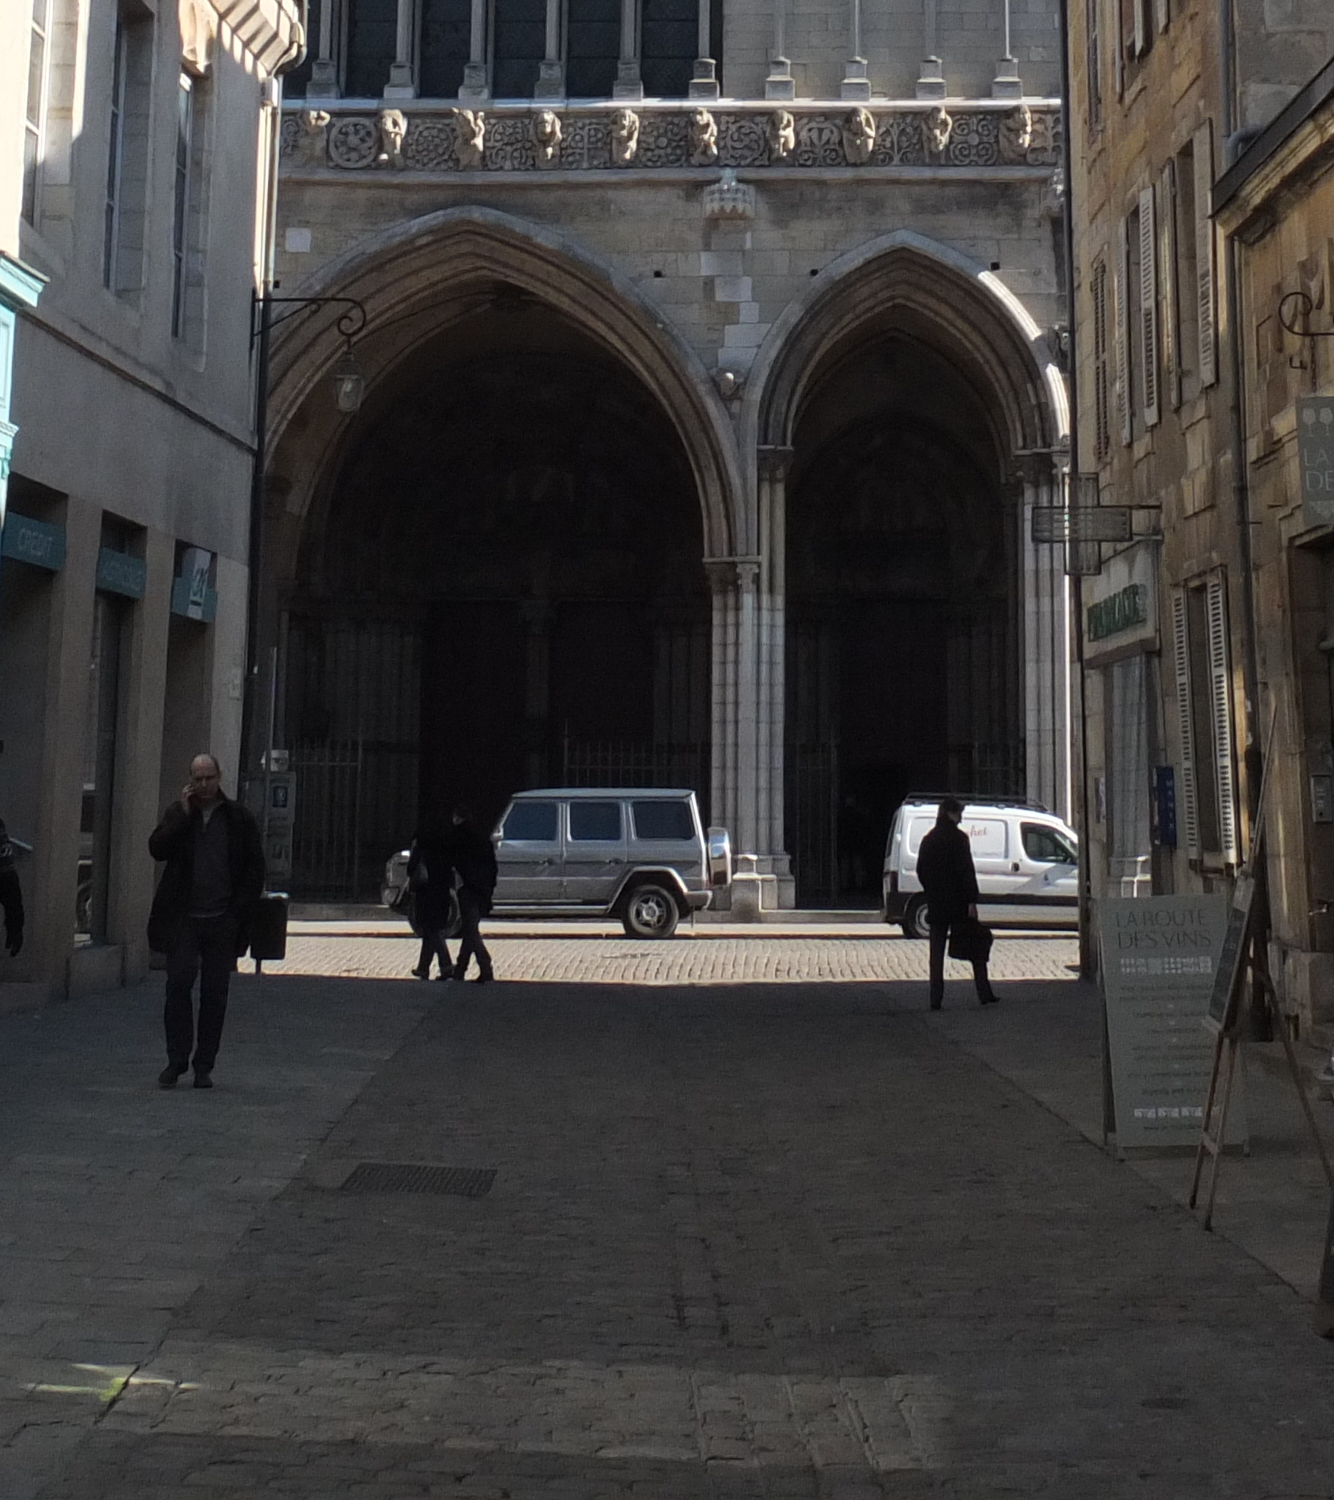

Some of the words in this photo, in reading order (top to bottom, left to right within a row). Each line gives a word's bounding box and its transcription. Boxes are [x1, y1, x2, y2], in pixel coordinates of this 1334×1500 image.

[1304, 447, 1330, 466] LA
[1115, 911, 1138, 928] LA
[1142, 908, 1208, 927] ROUTE
[1117, 931, 1157, 949] DES
[1161, 929, 1212, 948] VINS
